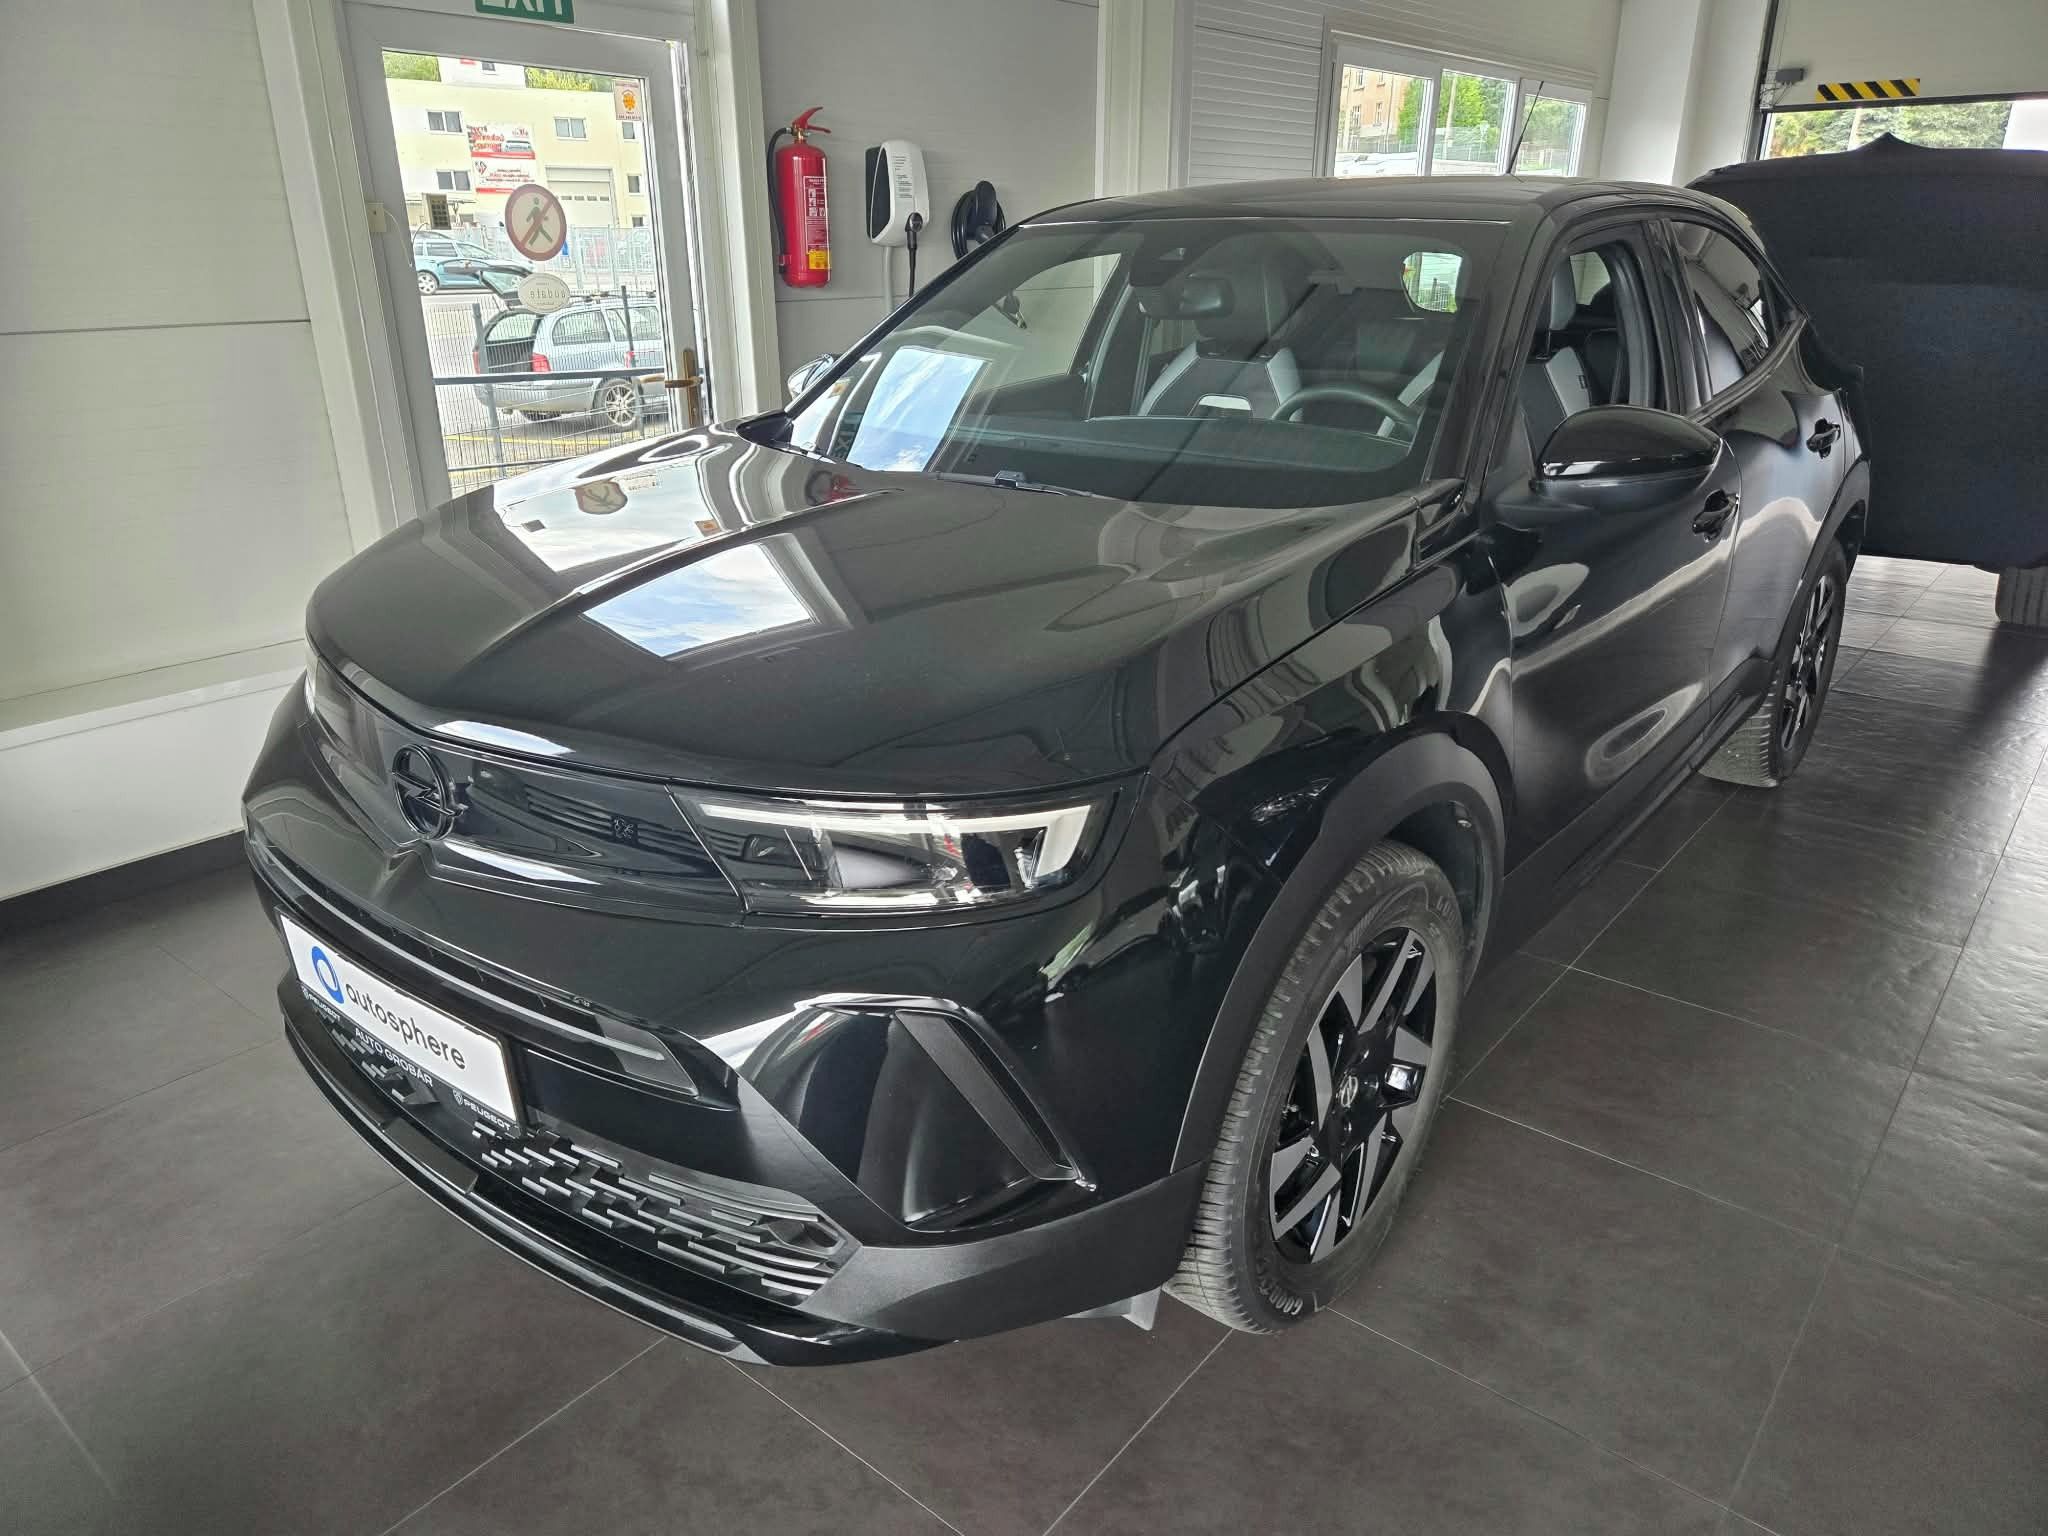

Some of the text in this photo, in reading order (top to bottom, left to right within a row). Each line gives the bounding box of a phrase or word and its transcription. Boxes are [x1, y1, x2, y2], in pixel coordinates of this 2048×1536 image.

[308, 993, 341, 1021] PEUGEOT
[345, 983, 466, 1070] autosphere
[355, 1027, 433, 1087] AUTO GROBAR
[463, 1098, 511, 1131] PEUGEOT
